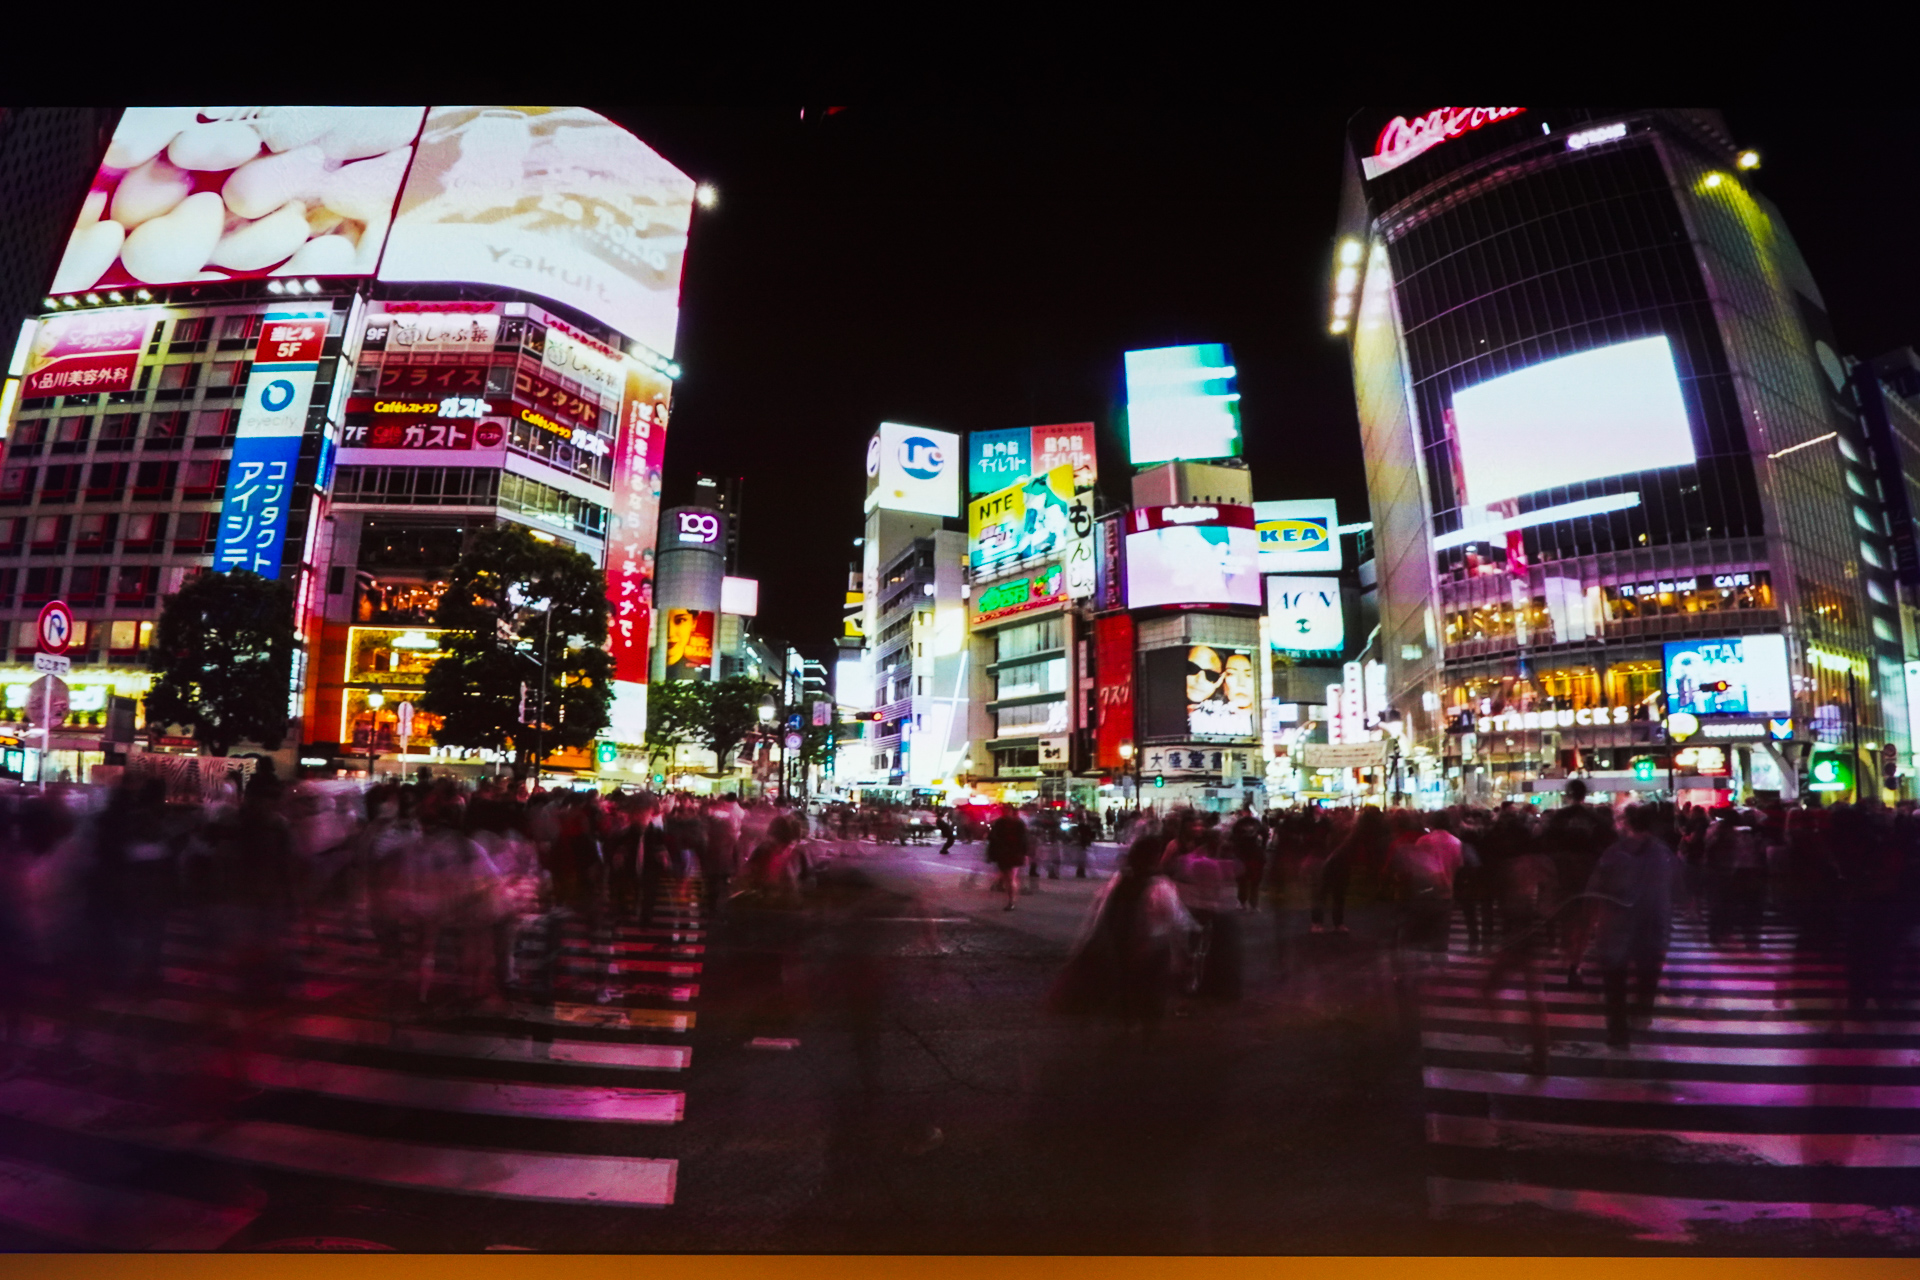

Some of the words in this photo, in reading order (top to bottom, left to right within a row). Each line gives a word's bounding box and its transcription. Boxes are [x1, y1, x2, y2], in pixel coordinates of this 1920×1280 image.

[486, 244, 611, 304] Yakult
[366, 328, 387, 341] 9F
[277, 342, 302, 357] 5F
[438, 398, 492, 417] ガスト
[516, 373, 596, 421] コンタクト
[345, 427, 369, 440] 7F
[402, 424, 467, 447] ガスト
[570, 429, 610, 456] ガスト
[254, 461, 287, 572] コンタクト
[679, 513, 718, 542] 109
[1260, 529, 1320, 542] KEA
[1714, 574, 1750, 587] CAFE
[36, 658, 68, 673] ここまで
[1478, 706, 1629, 733] STARBUCKS
